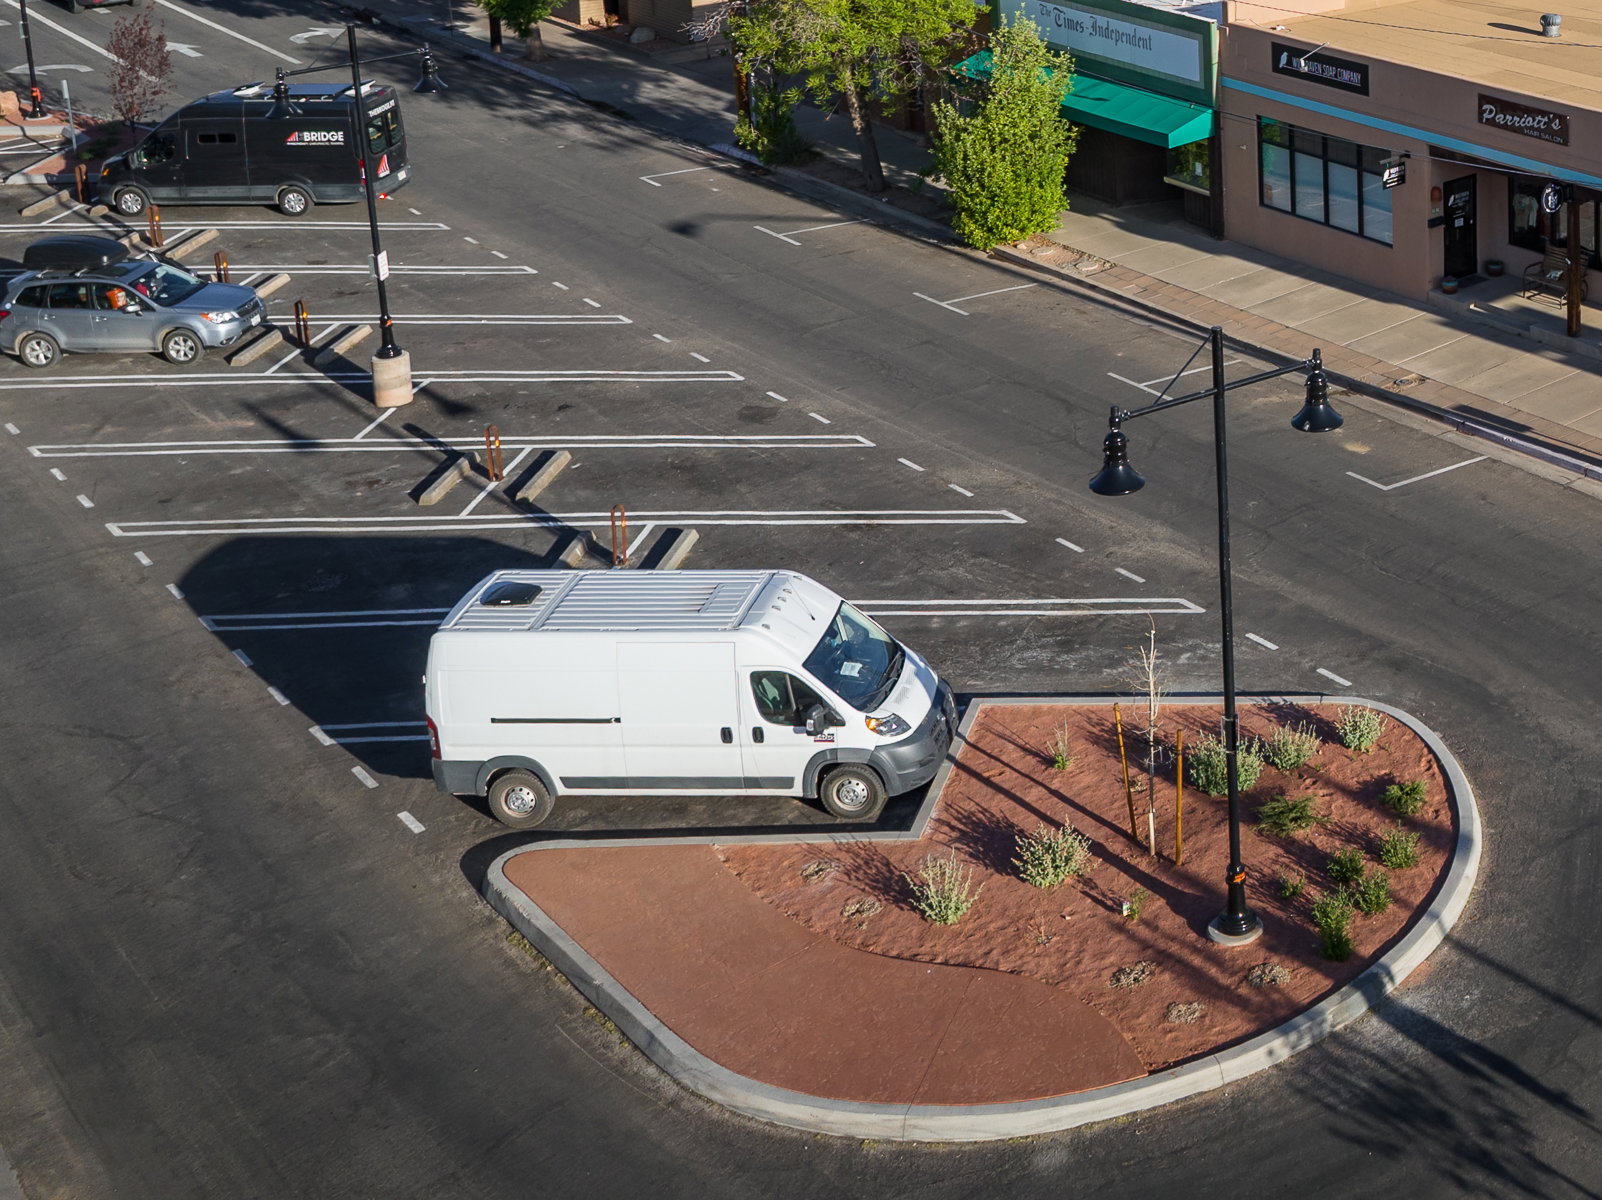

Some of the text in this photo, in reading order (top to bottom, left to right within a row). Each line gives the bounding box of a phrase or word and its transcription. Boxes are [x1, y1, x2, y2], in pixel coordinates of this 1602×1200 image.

[1039, 3, 1153, 52] The Times-Independent
[1323, 64, 1336, 79] SOAP
[1337, 68, 1362, 85] COMPANY
[1482, 104, 1561, 130] Parriott's
[303, 131, 344, 142] BRIDGE
[1524, 127, 1563, 144] HAIR SALON
